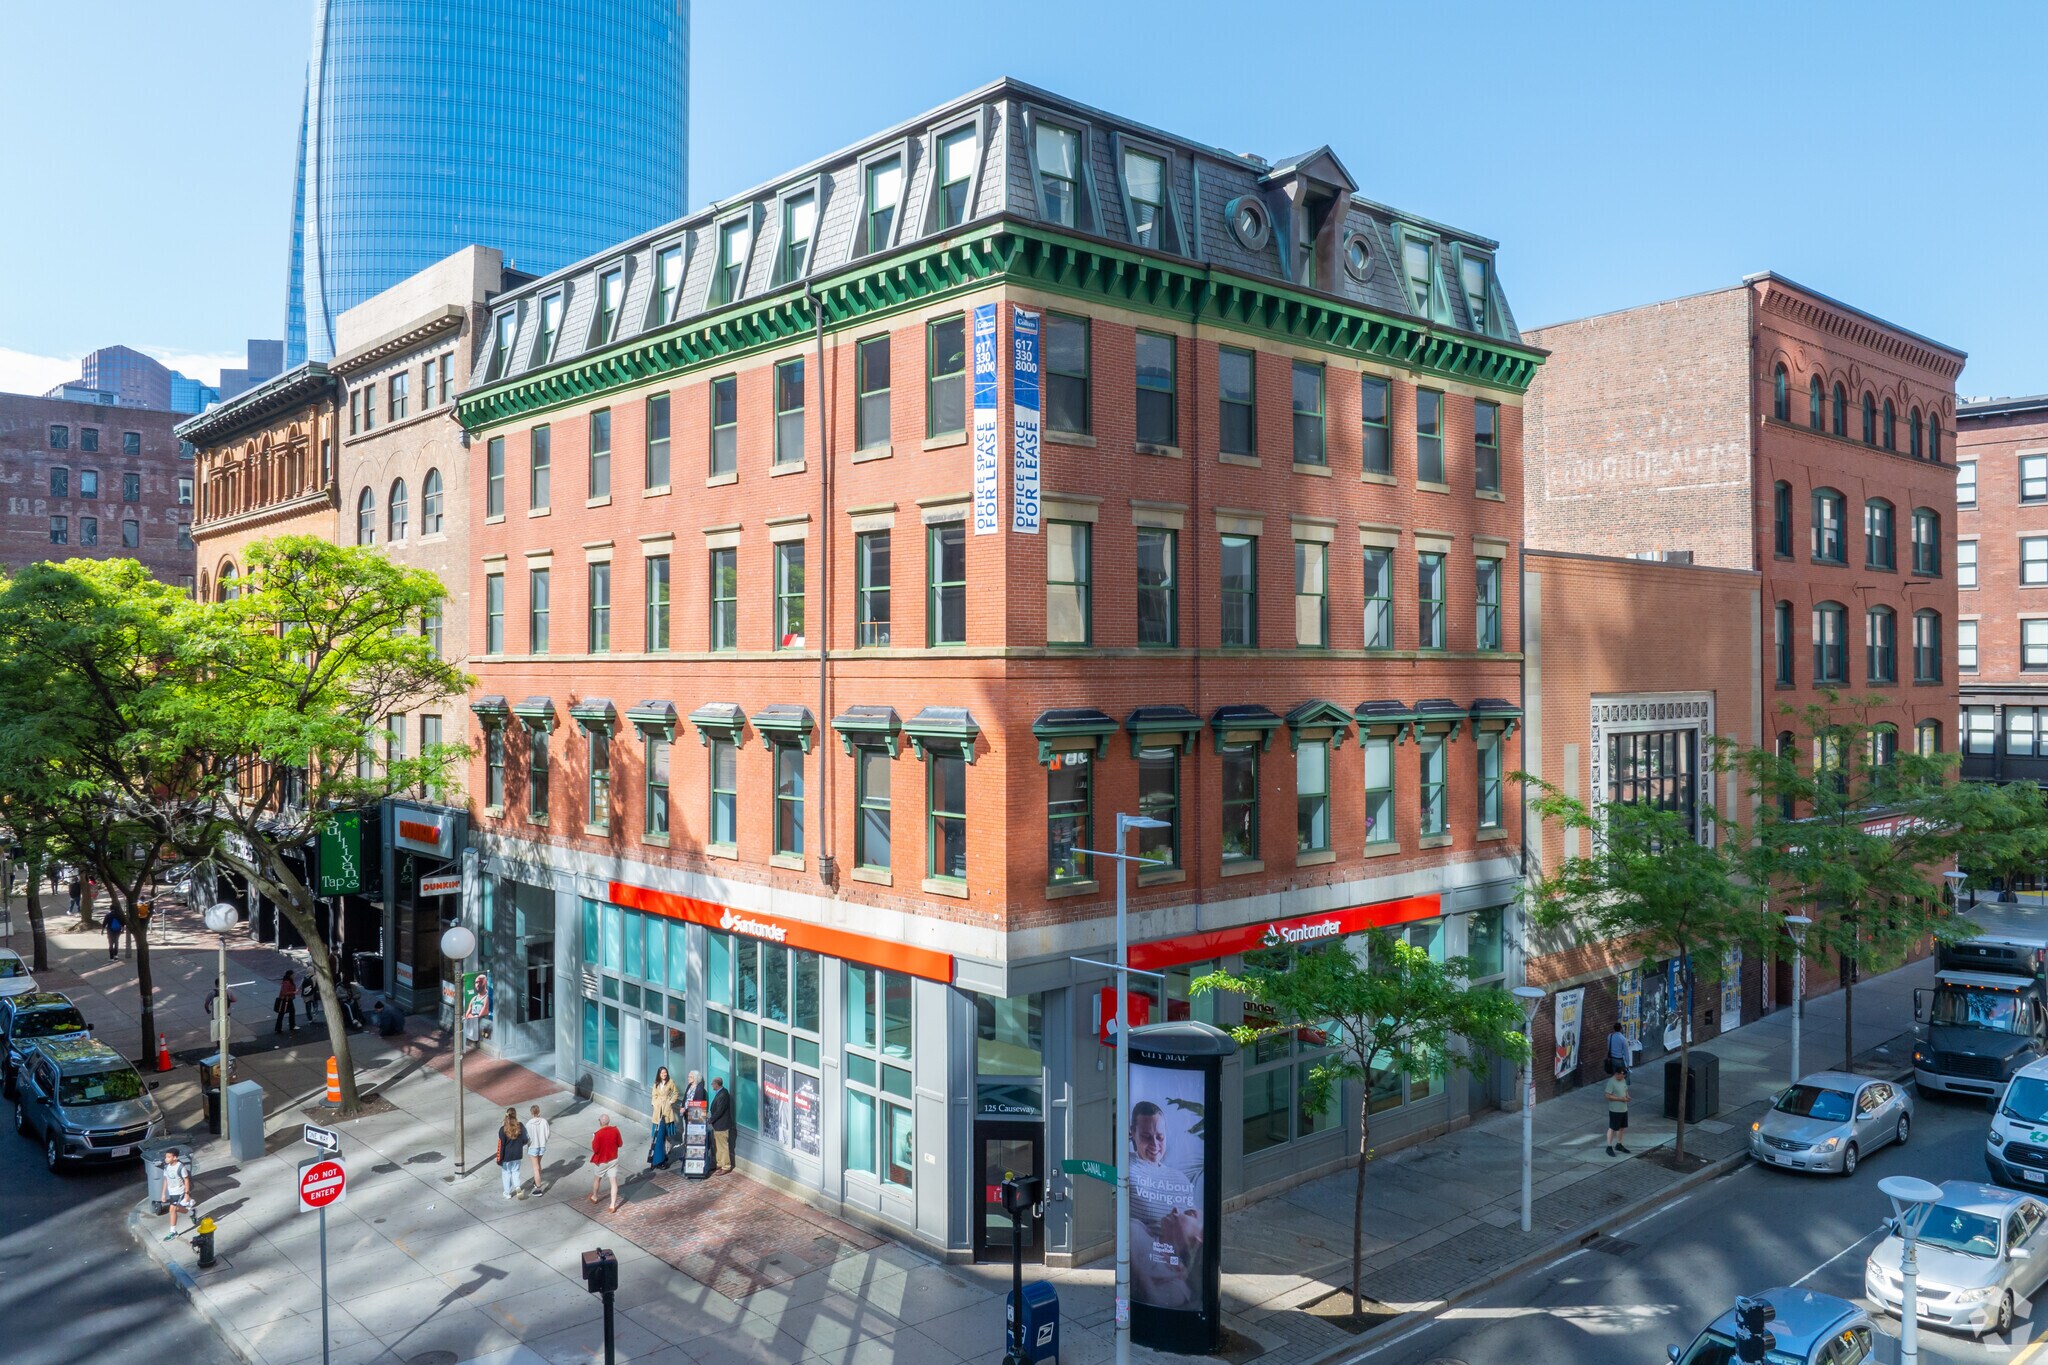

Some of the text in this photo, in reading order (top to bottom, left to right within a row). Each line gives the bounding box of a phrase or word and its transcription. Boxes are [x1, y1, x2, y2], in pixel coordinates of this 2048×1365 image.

[975, 341, 990, 353] 617
[1015, 339, 1032, 350] 617
[975, 352, 991, 365] 330
[1015, 350, 1032, 361] 330
[976, 362, 995, 375] 8000
[1015, 361, 1037, 373] 8000
[977, 424, 985, 529] OFFICE SPACE
[985, 421, 996, 528] FOR LEASE
[1016, 421, 1025, 527] OFFICE SPACE
[1026, 422, 1038, 528] FOR LEASE
[322, 876, 345, 890] Tap
[423, 880, 460, 891] DUNKIN'
[732, 915, 788, 943] Santander
[1280, 919, 1342, 943] Santander
[984, 1103, 1035, 1115] 125 Causeway
[308, 1130, 328, 1142] ONE WAY
[308, 1168, 338, 1182] DO NOT
[1081, 1160, 1102, 1177] CANAL
[1136, 1177, 1195, 1193] TalkAbout
[310, 1187, 335, 1200] ENTER
[1135, 1186, 1194, 1207] Vaping.org
